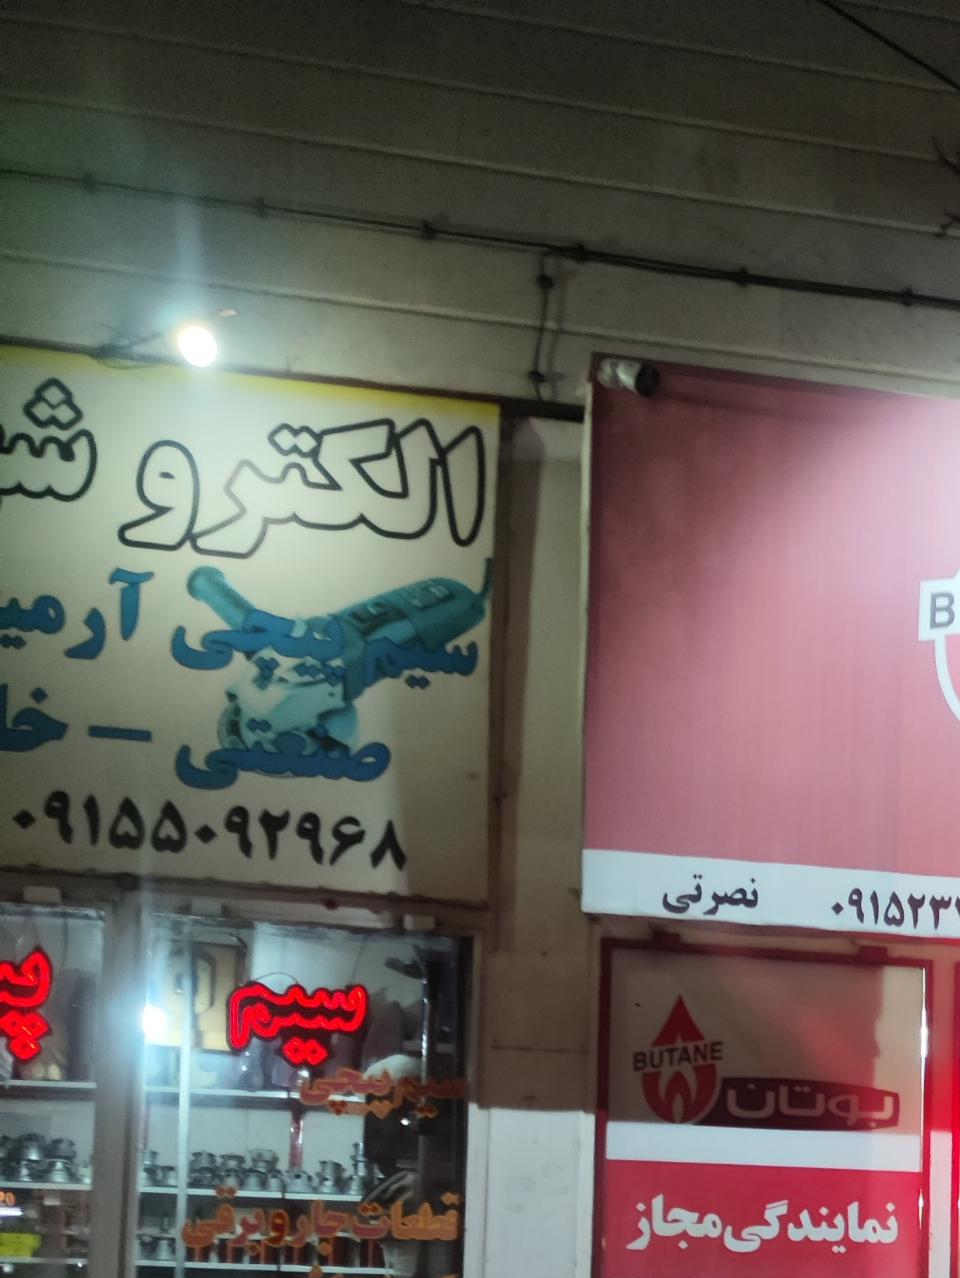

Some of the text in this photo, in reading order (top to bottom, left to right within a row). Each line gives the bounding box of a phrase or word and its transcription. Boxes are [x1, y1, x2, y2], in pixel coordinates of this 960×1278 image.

[0, 377, 486, 559] الکترو ش
[0, 567, 478, 692] سیم پیچی آرمی
[175, 720, 391, 790] صنعتی
[12, 790, 408, 872] ۰۹۱۵۵۰۹۲۹۶۸
[662, 873, 760, 916] نصرتی
[228, 981, 370, 1066] سیم
[632, 1041, 725, 1073] BUTANE
[725, 1080, 896, 1126] بوتان
[354, 1190, 461, 1242] قطعات
[627, 1193, 898, 1255] نمایندگی مجاز
